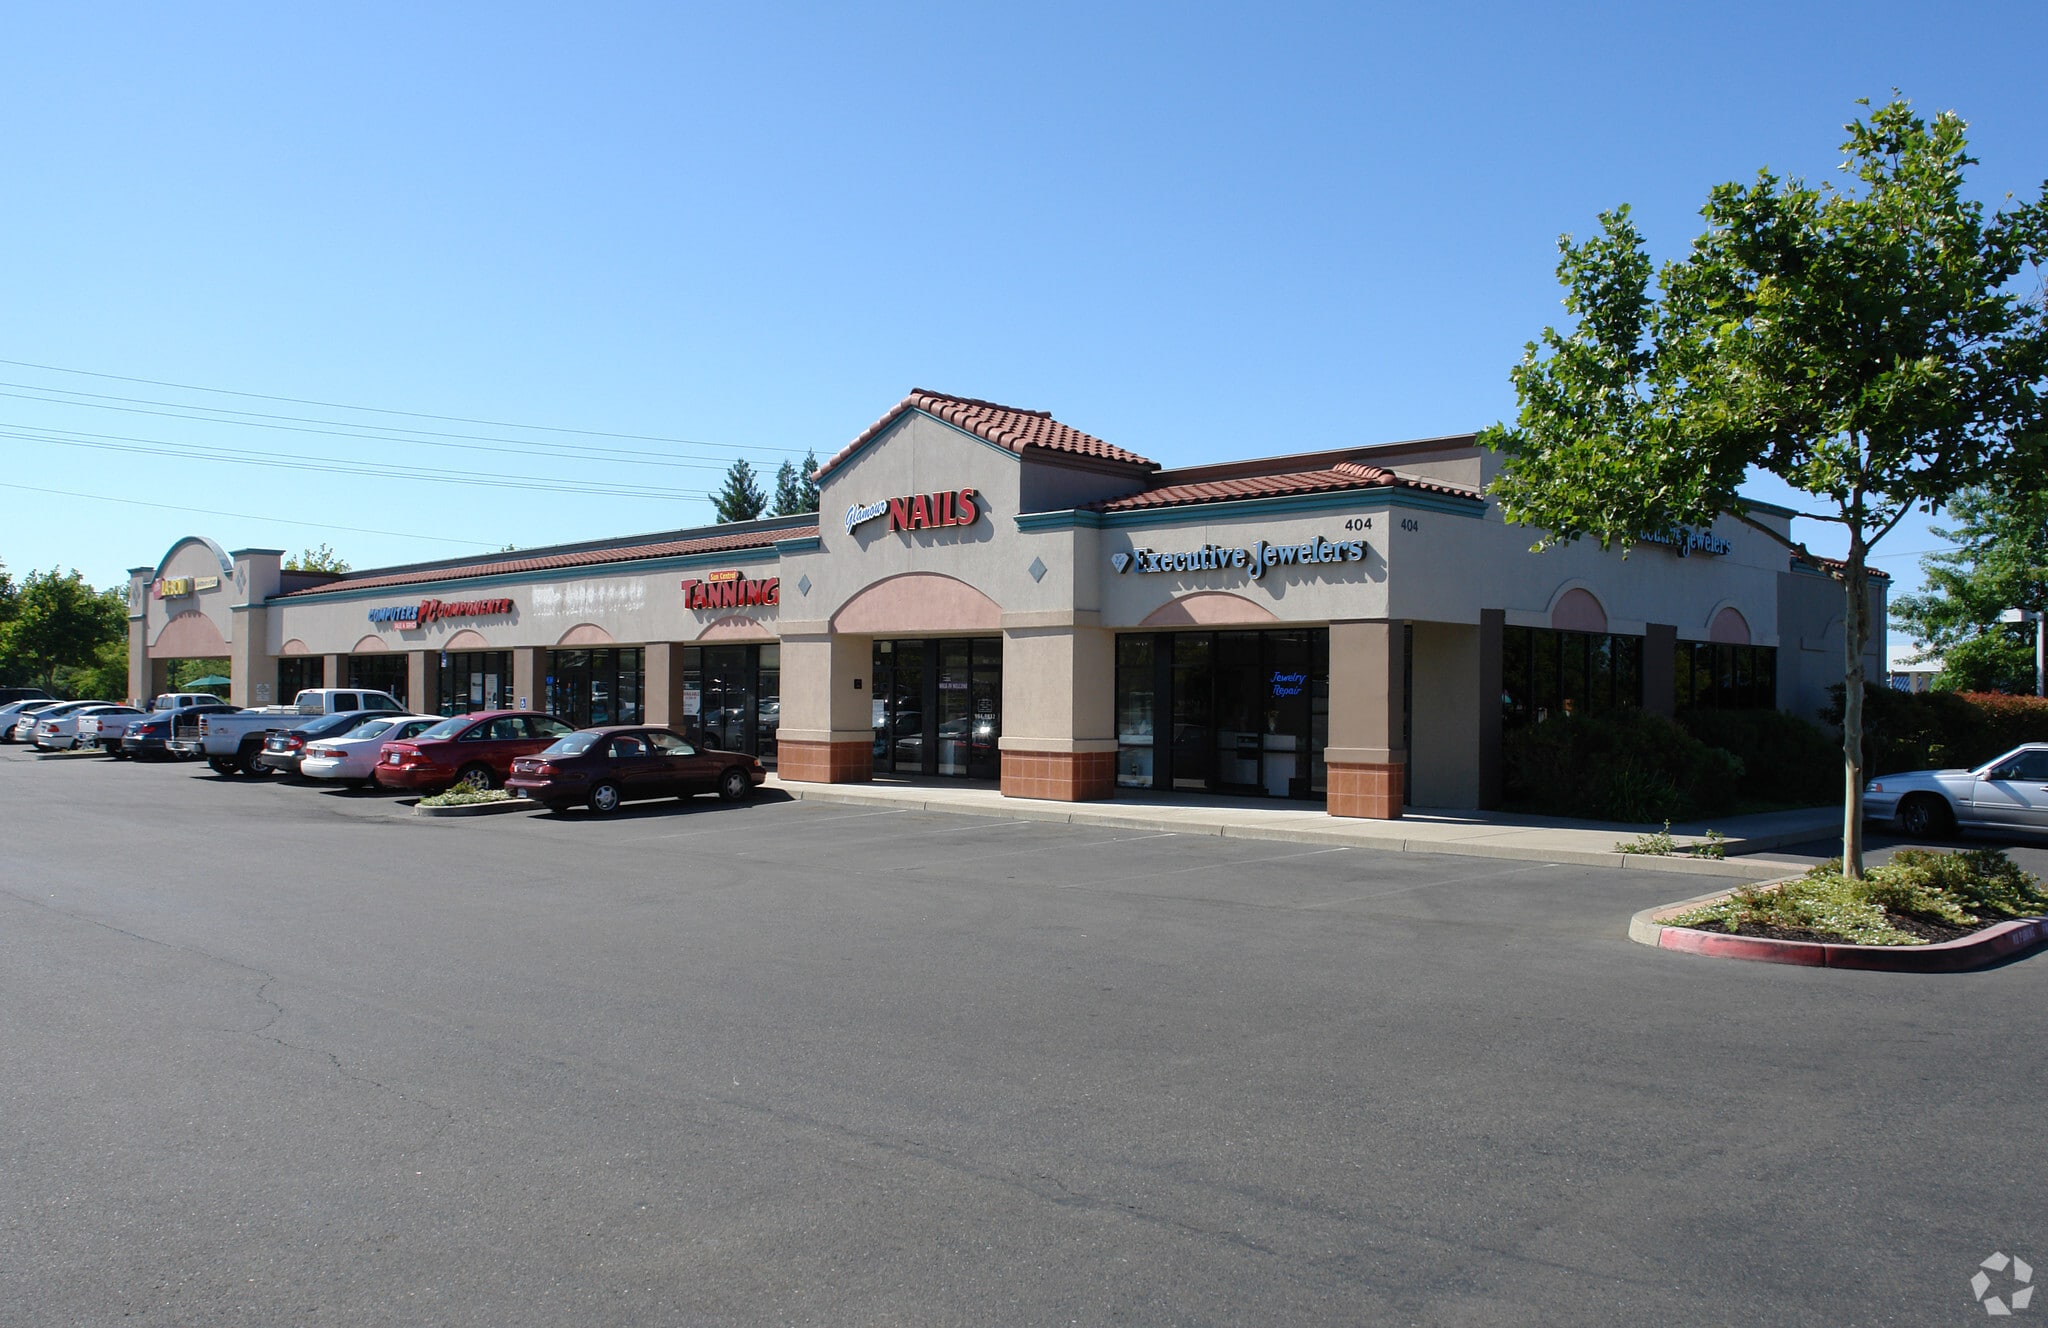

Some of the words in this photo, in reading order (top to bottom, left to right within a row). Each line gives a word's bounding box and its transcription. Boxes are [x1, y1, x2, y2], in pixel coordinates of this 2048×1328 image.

[845, 500, 887, 535] Glamour
[889, 487, 976, 531] NAILS
[1345, 518, 1373, 531] 404
[1400, 519, 1419, 532] 404
[1133, 544, 1246, 573] Executive
[1247, 536, 1364, 580] Jewelers
[681, 577, 779, 609] TANNING
[368, 606, 418, 622] COMPUTERS
[418, 599, 440, 623] PC
[437, 598, 510, 617] COMPONENTS
[1270, 671, 1307, 685] Jewelry
[1273, 684, 1302, 697] Repair
